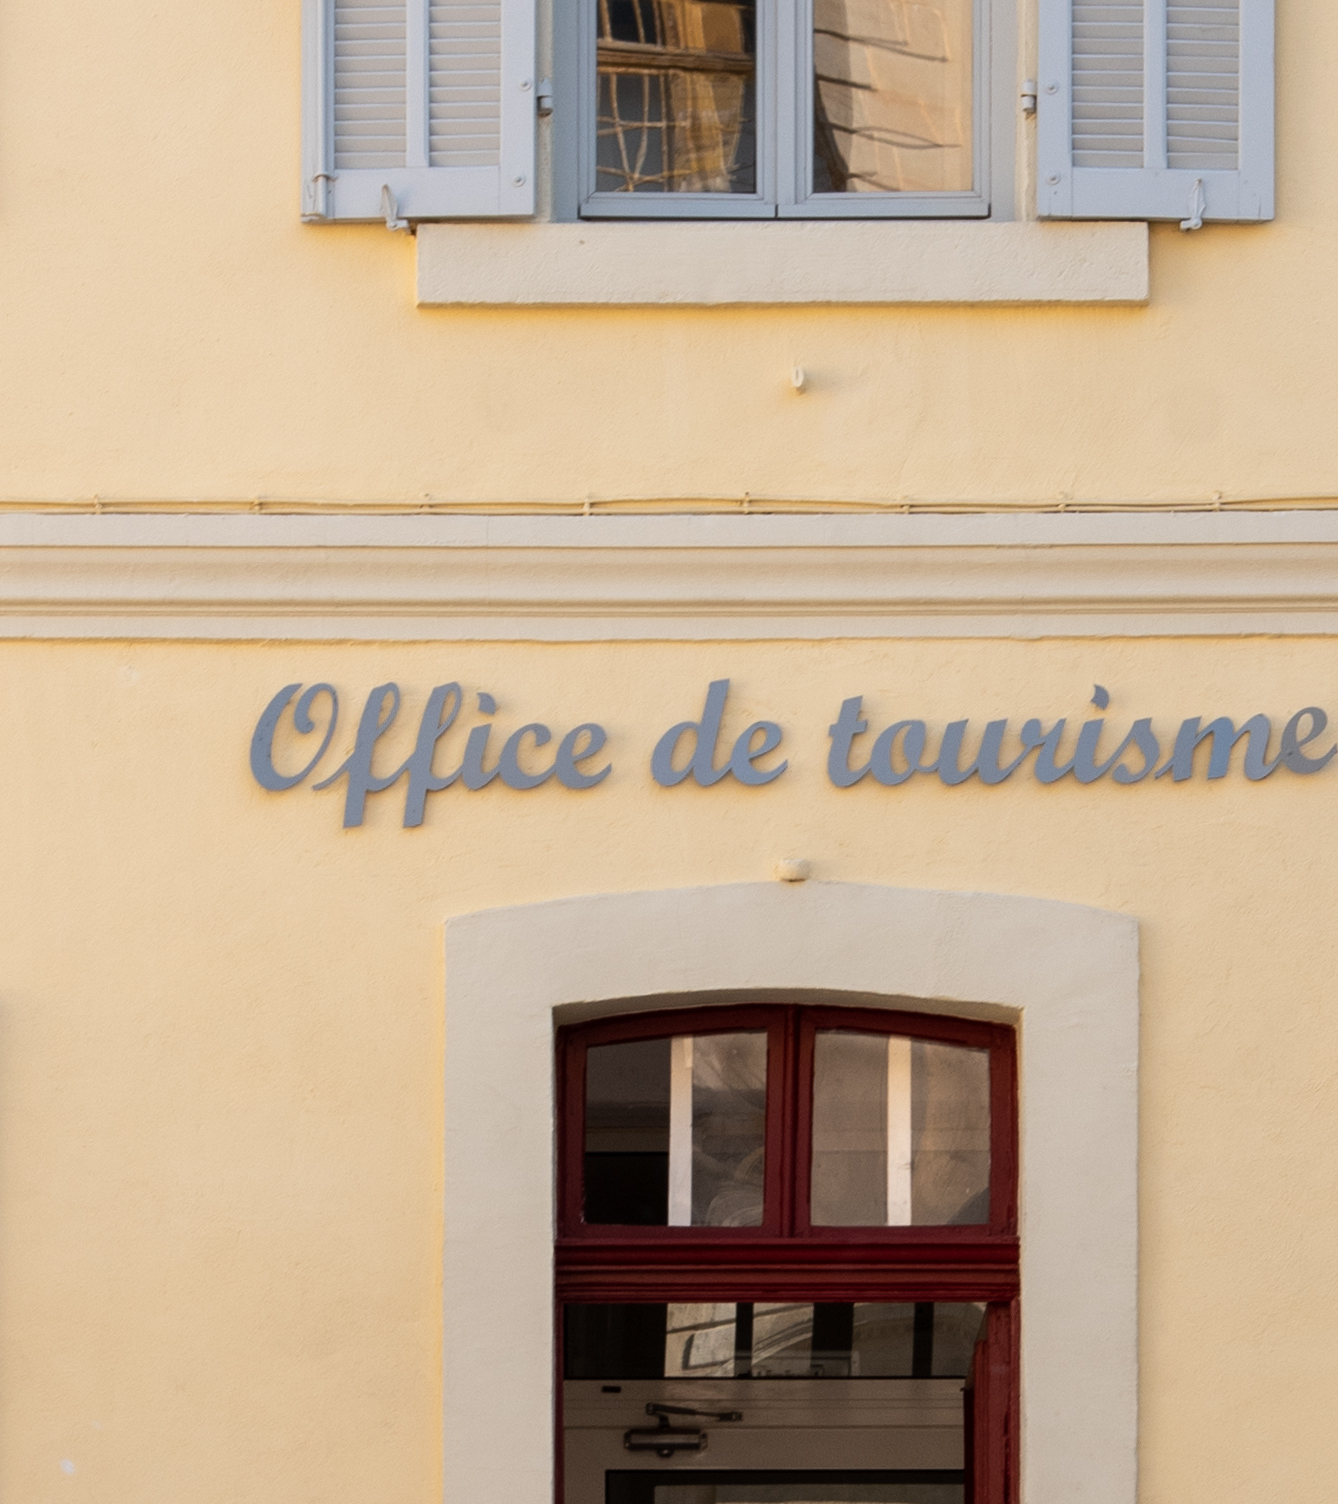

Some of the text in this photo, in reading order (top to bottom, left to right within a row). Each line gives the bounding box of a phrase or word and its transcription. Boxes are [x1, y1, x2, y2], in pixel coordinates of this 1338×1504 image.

[249, 679, 1338, 828] Office de tourisme
